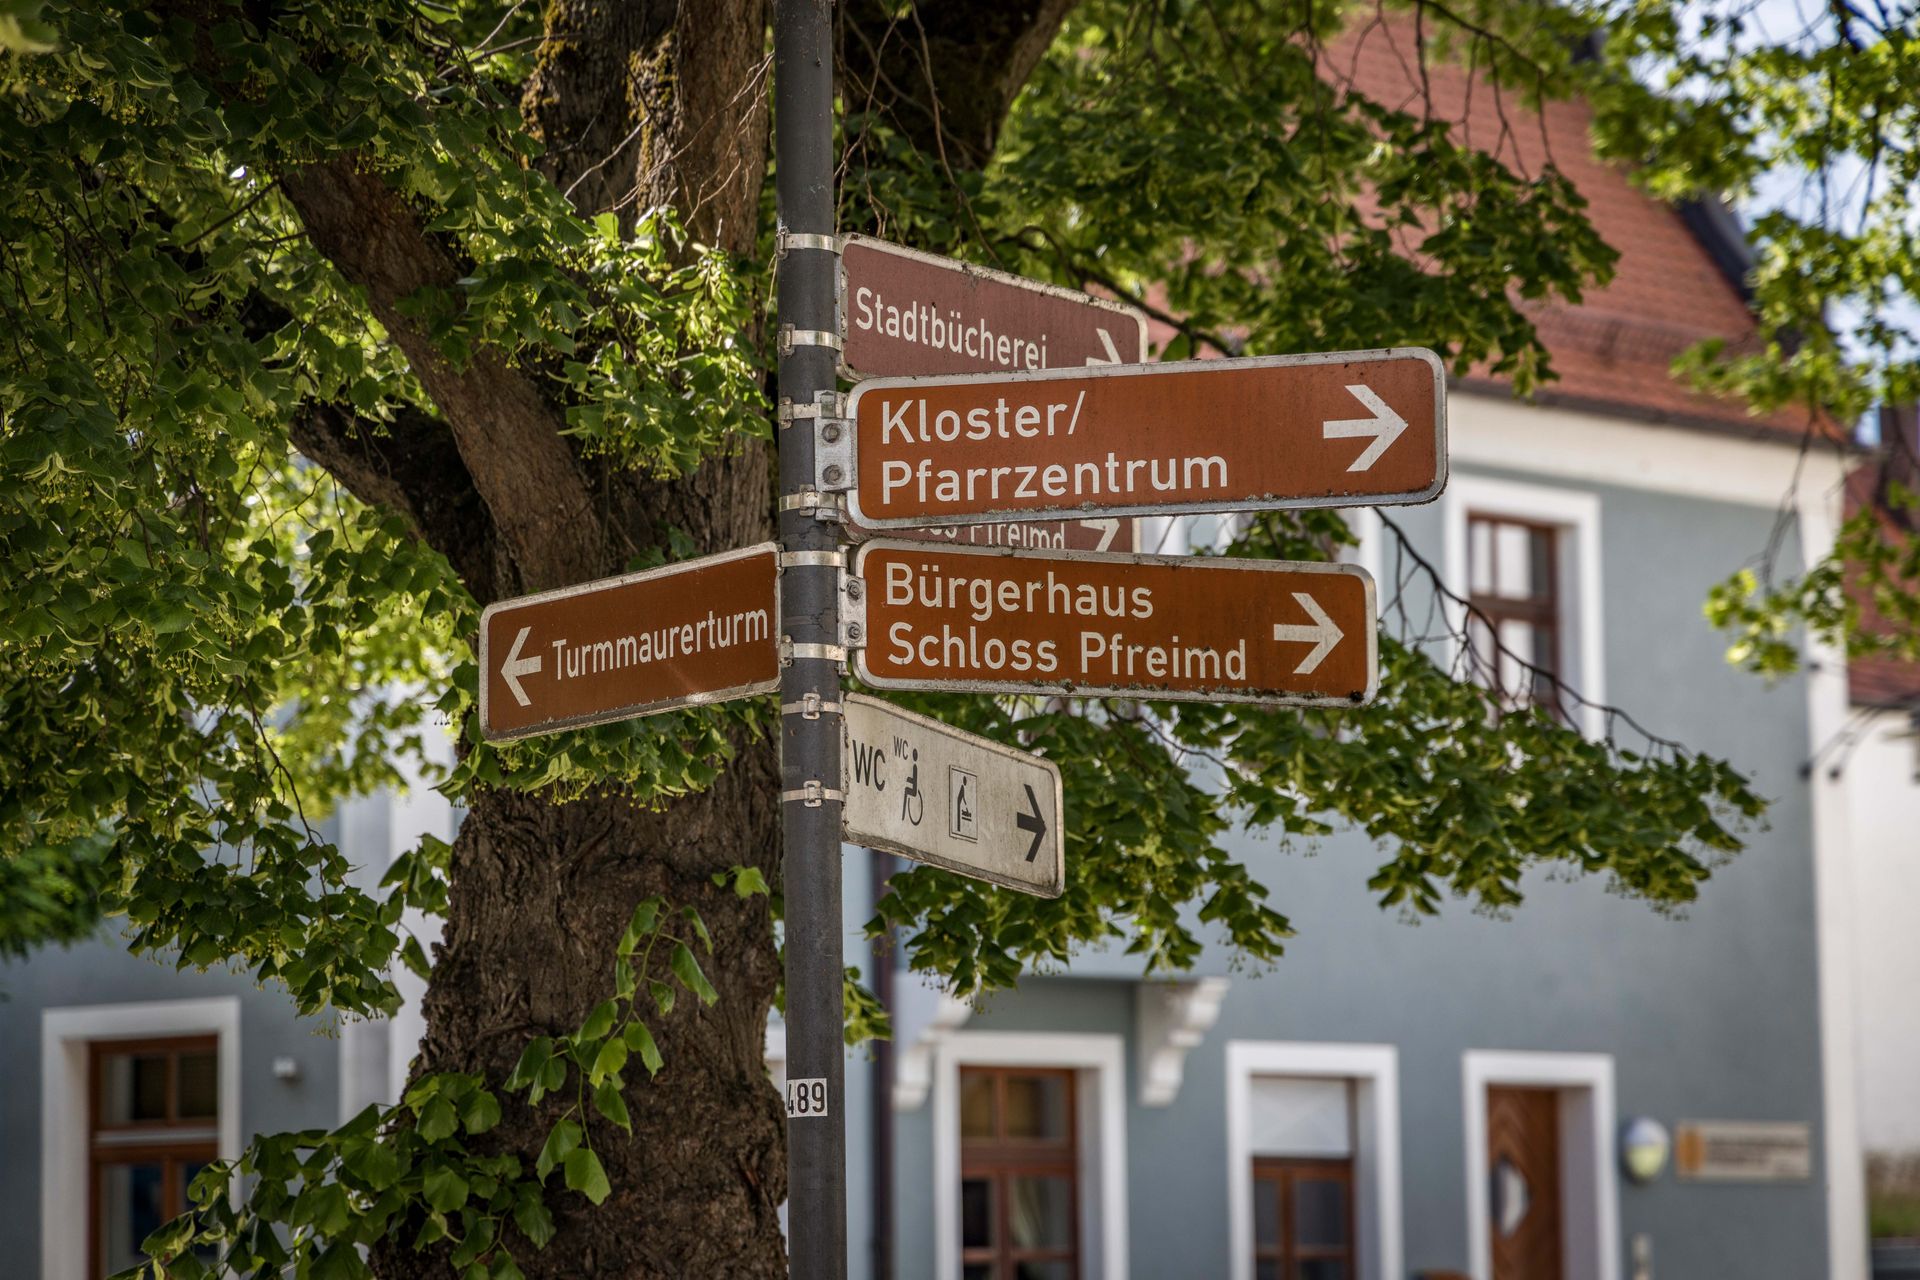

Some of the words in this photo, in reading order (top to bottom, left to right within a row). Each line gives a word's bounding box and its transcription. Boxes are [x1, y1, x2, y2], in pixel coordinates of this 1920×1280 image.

[855, 286, 1047, 370] Stadtbücherei
[882, 390, 1086, 444] Kloster/
[882, 452, 1229, 504] Pfarrzentrum
[886, 562, 1154, 622] Bürgerhaus
[552, 608, 768, 680] Turmmaurerturm
[888, 621, 1058, 673] Schloss
[1080, 631, 1246, 681] Pfreimd
[852, 739, 886, 792] WC
[893, 735, 909, 760] WC
